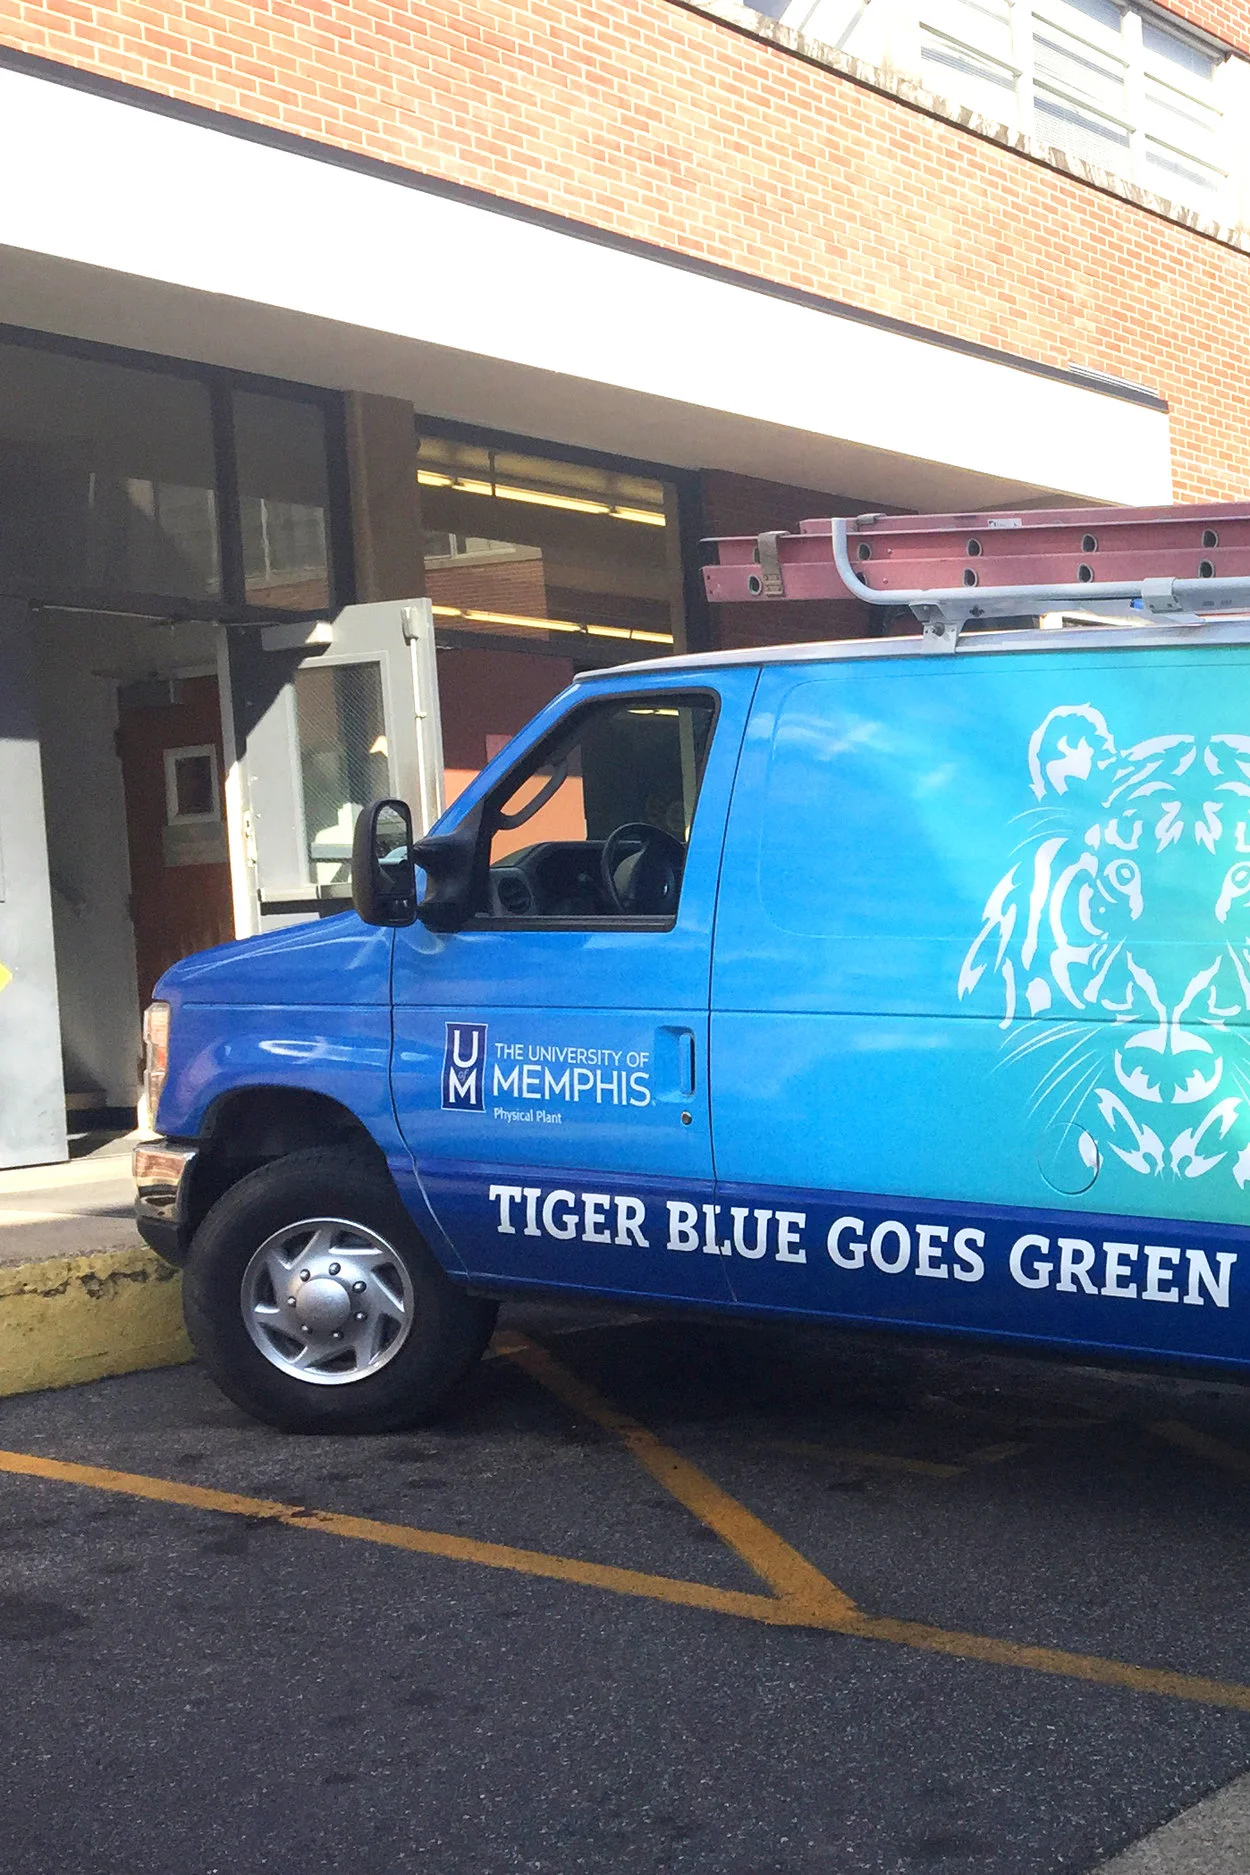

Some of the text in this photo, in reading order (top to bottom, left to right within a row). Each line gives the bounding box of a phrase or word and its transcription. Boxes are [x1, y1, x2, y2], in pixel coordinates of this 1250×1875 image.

[494, 1043, 650, 1068] THE UNIVERSITY OF
[493, 1063, 651, 1107] MEMPHIS
[493, 1107, 562, 1124] Physical Plant
[489, 1184, 1238, 1308] TIGER BLUE GOES GREEN
